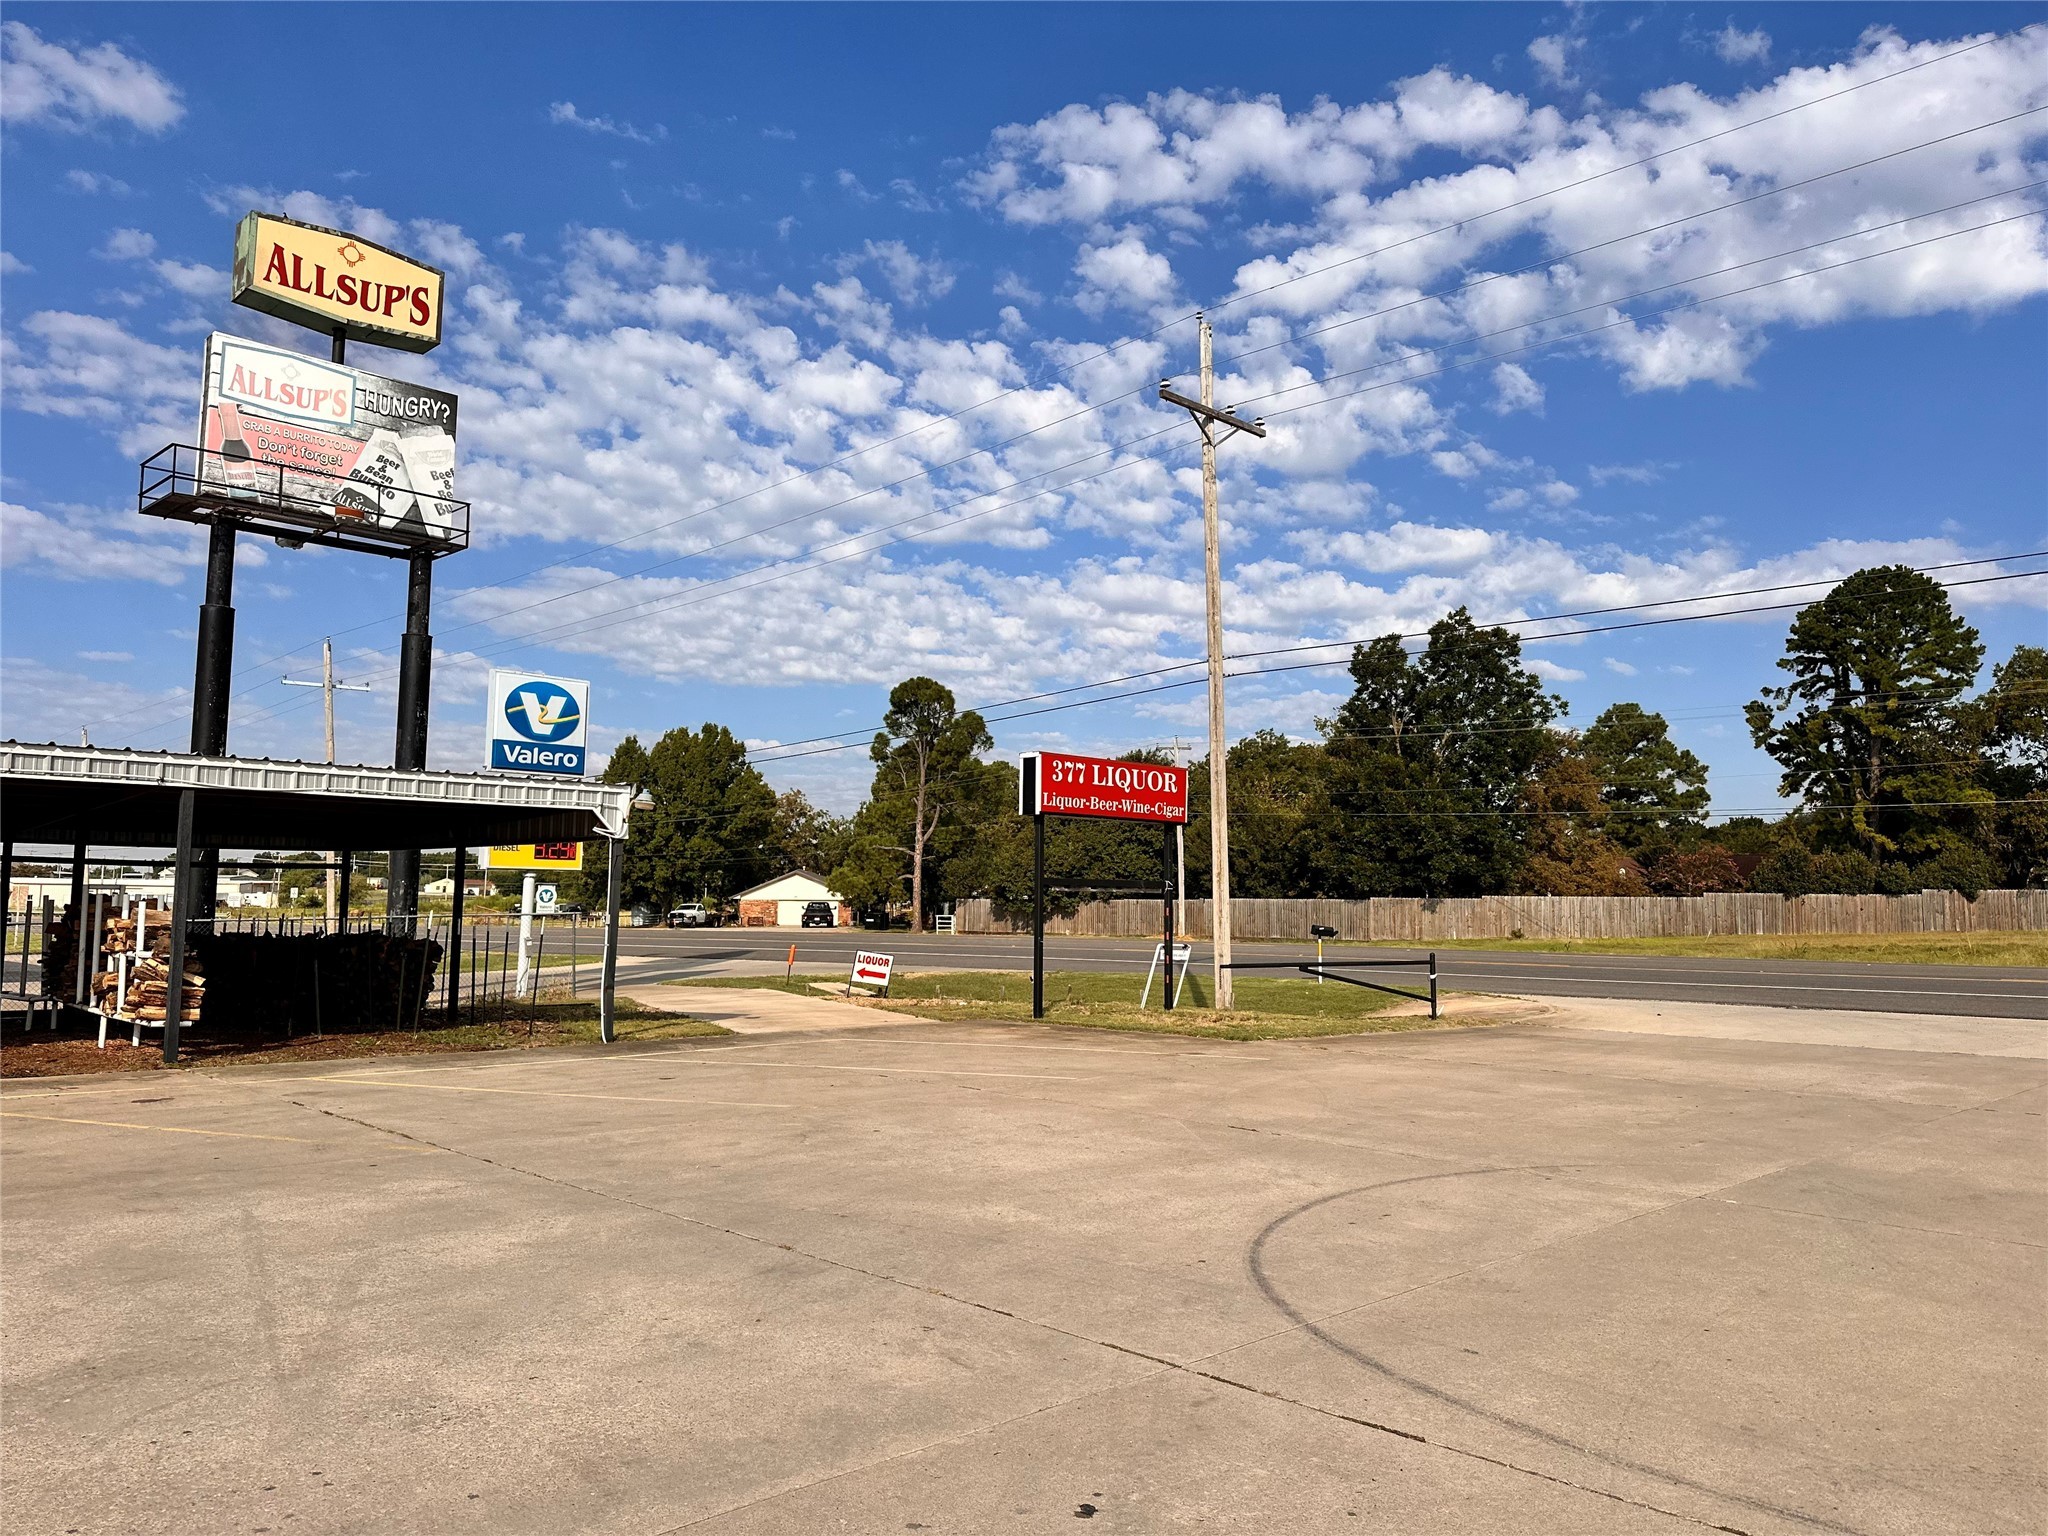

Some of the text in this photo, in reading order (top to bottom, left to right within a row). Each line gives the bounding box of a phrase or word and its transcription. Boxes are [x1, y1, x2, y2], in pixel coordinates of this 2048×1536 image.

[263, 243, 430, 327] ALLSUP'S
[228, 364, 347, 417] ALLSUP'S
[365, 388, 451, 423] HUNGRY?
[242, 420, 360, 454] GRAB A BURRITO TODAY
[258, 437, 344, 466] Don't forget
[262, 453, 285, 469] the
[376, 455, 401, 471] Beef
[364, 465, 394, 485] Bean
[378, 465, 388, 473] &
[503, 744, 577, 768] Valero
[1052, 759, 1178, 793] 377 LIQUOR
[1043, 792, 1185, 819] Liquor-Beer-Wine-Cigar
[493, 844, 520, 852] DIESEL
[857, 954, 890, 967] LIQUOR
